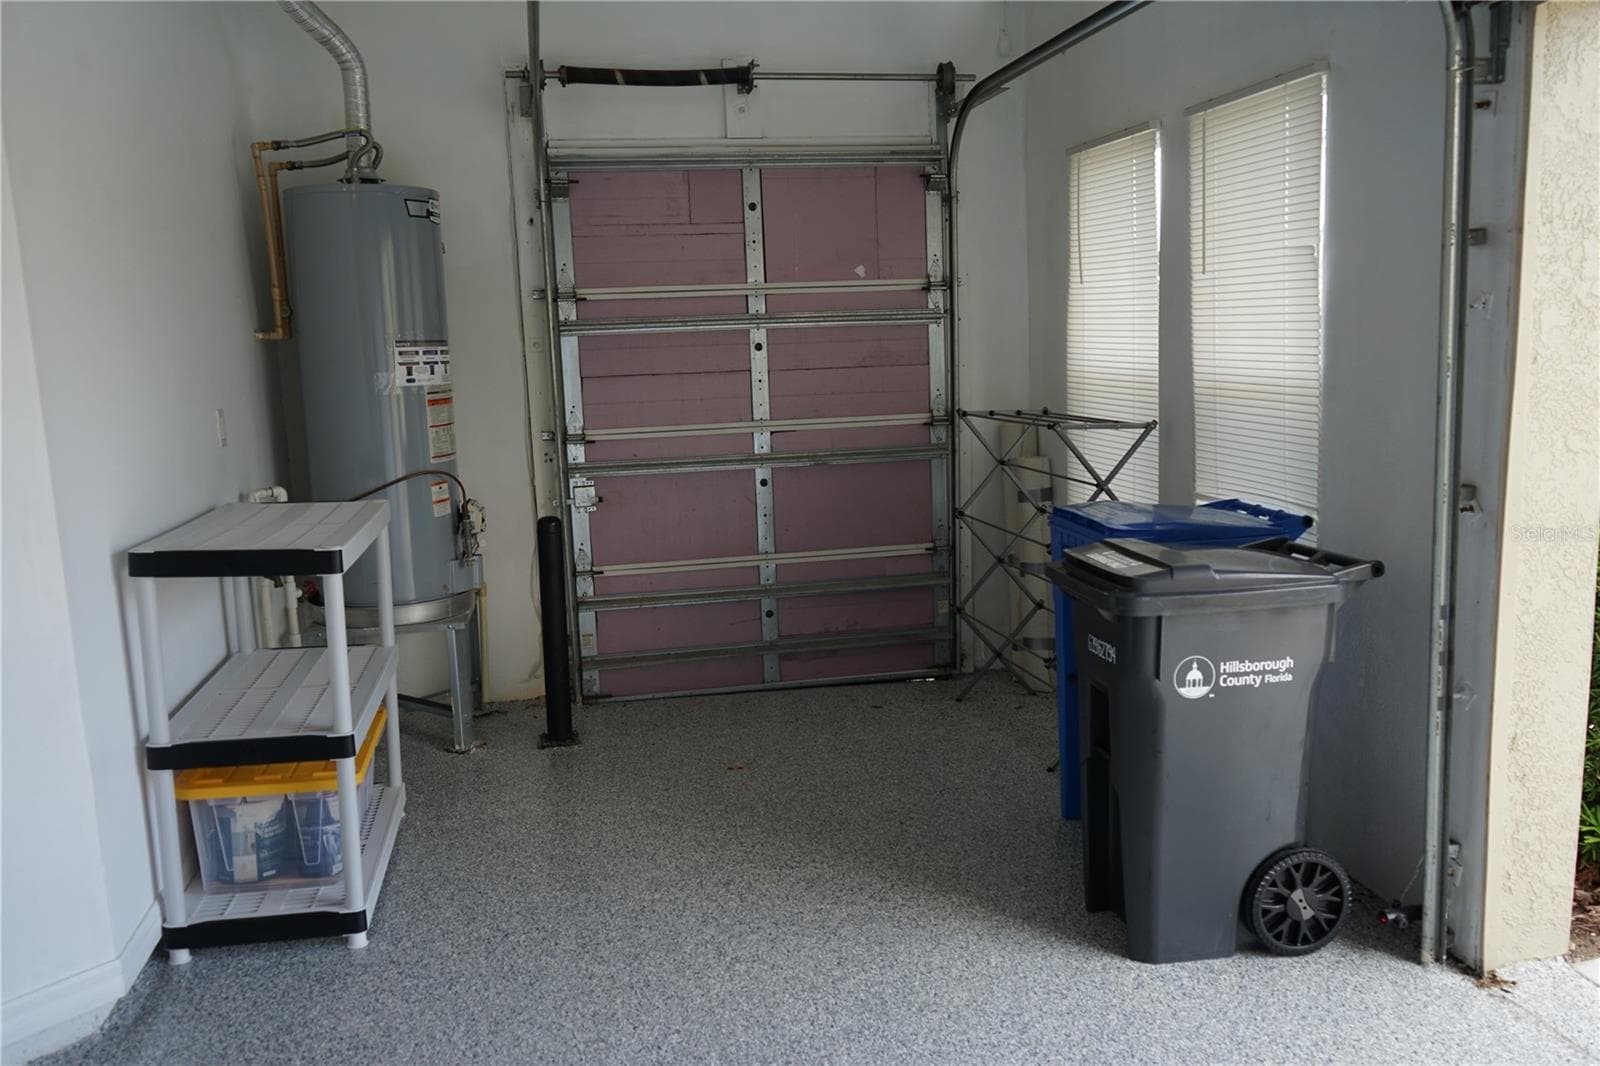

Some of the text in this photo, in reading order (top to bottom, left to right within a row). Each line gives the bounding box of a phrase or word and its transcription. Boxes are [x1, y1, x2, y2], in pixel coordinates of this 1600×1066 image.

[1220, 656, 1294, 673] Hillsborough
[1220, 672, 1293, 688] County Florida
